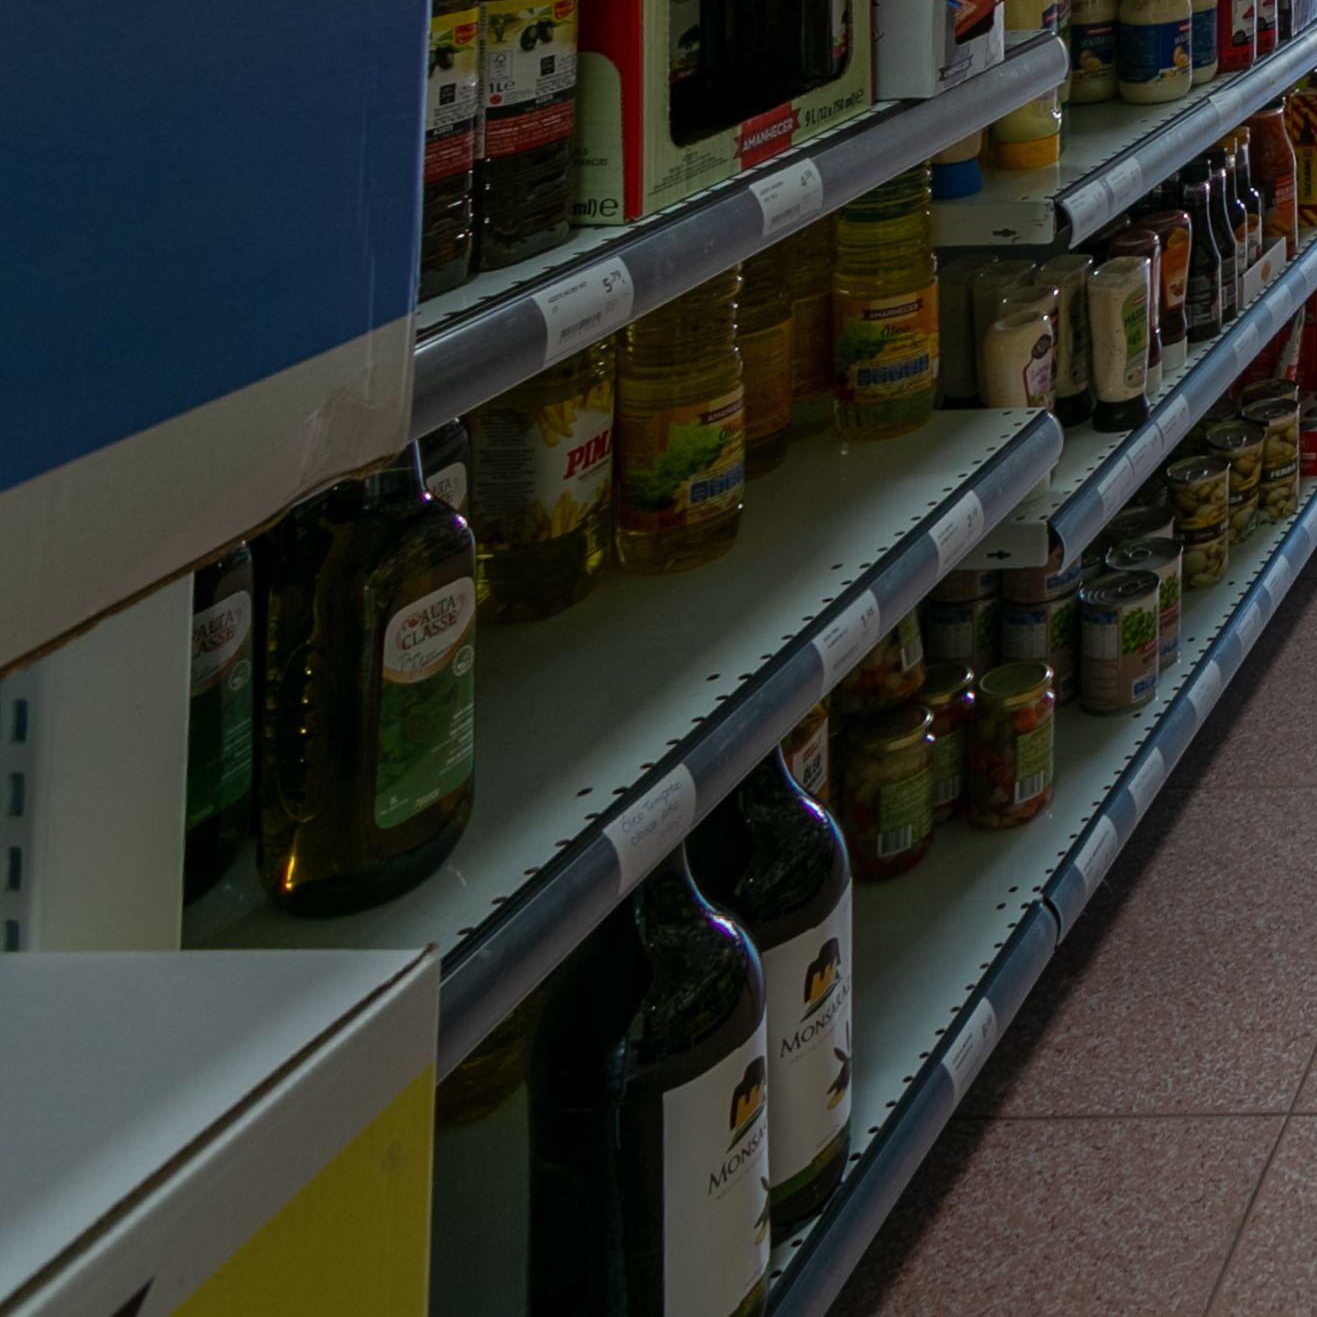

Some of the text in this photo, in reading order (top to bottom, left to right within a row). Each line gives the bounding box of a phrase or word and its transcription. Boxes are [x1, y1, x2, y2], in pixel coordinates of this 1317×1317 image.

[742, 118, 794, 152] AMANHECER
[420, 595, 457, 625] ALTA
[401, 610, 457, 653] CLASSE
